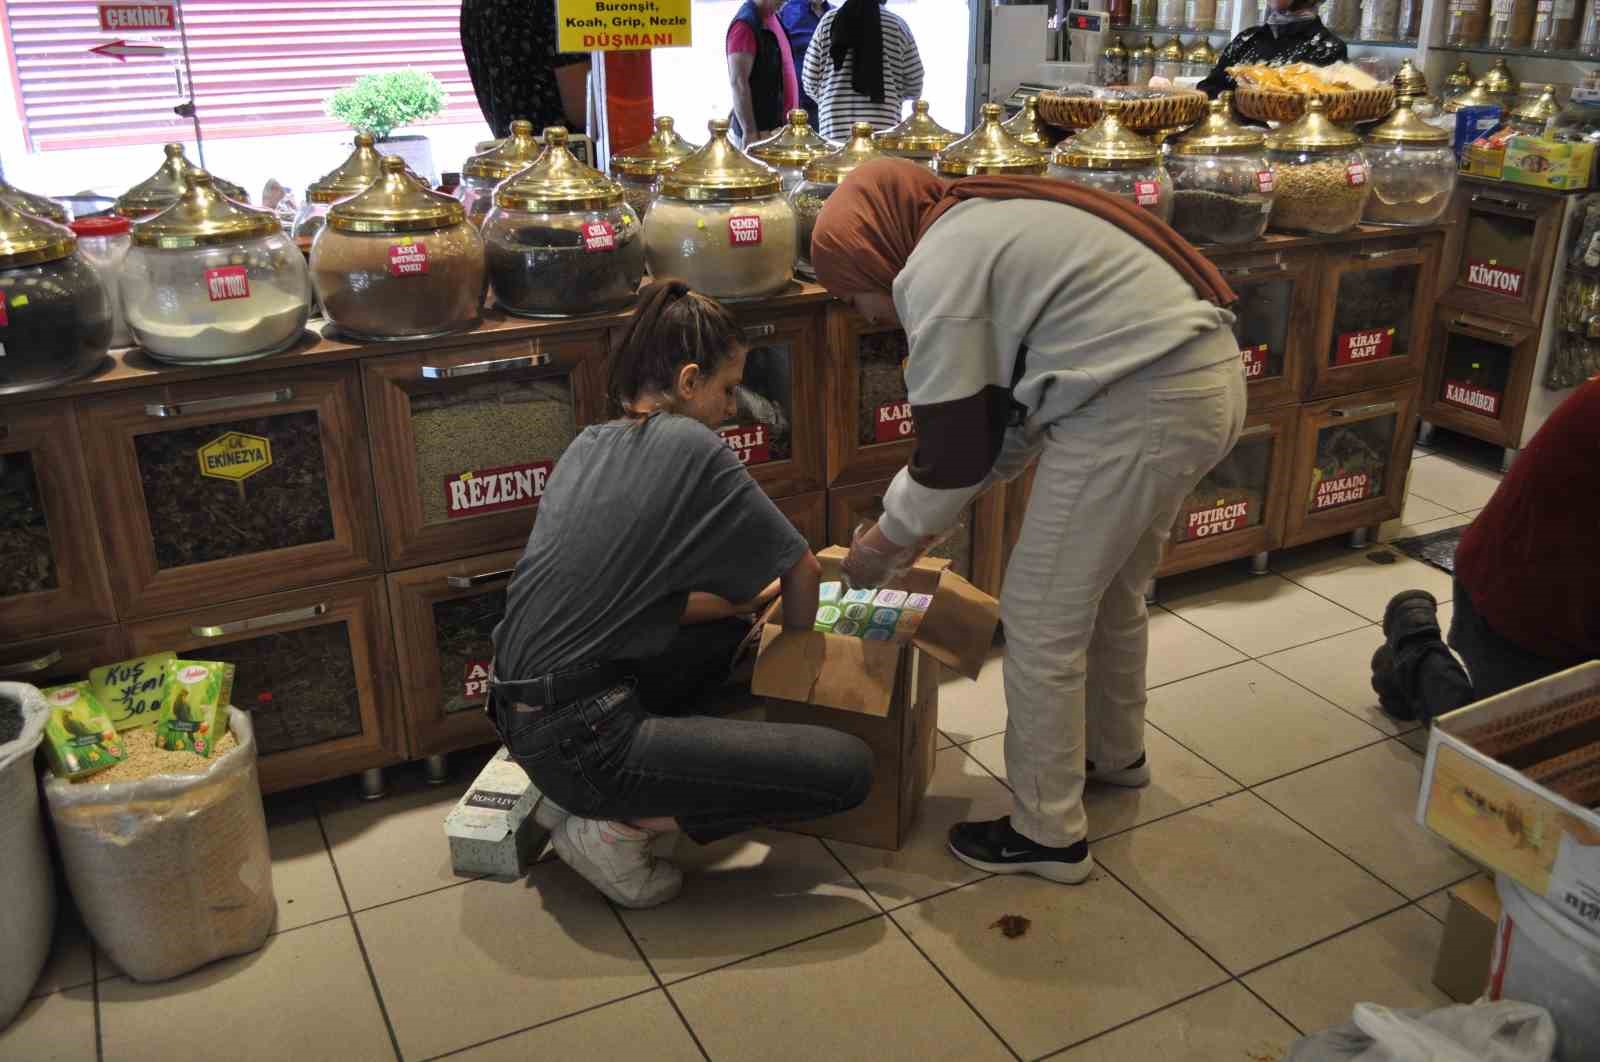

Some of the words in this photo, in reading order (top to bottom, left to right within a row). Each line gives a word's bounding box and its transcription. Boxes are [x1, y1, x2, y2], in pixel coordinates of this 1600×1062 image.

[596, 2, 659, 13] Buronşit,
[566, 18, 607, 28] Koah,
[612, 17, 645, 27] Grip,
[650, 16, 687, 26] Nezle
[583, 32, 672, 48] DÜŞMANI
[1468, 264, 1521, 292] KİMYON
[1349, 333, 1382, 349] KİRAZ
[1246, 361, 1262, 377] LÜ
[1446, 383, 1496, 413] KARABİBER
[880, 403, 912, 422] KAR
[899, 420, 914, 435] O
[207, 448, 265, 469] EKİNEZYA
[449, 467, 547, 511] REZENE
[1196, 518, 1235, 537] OTU
